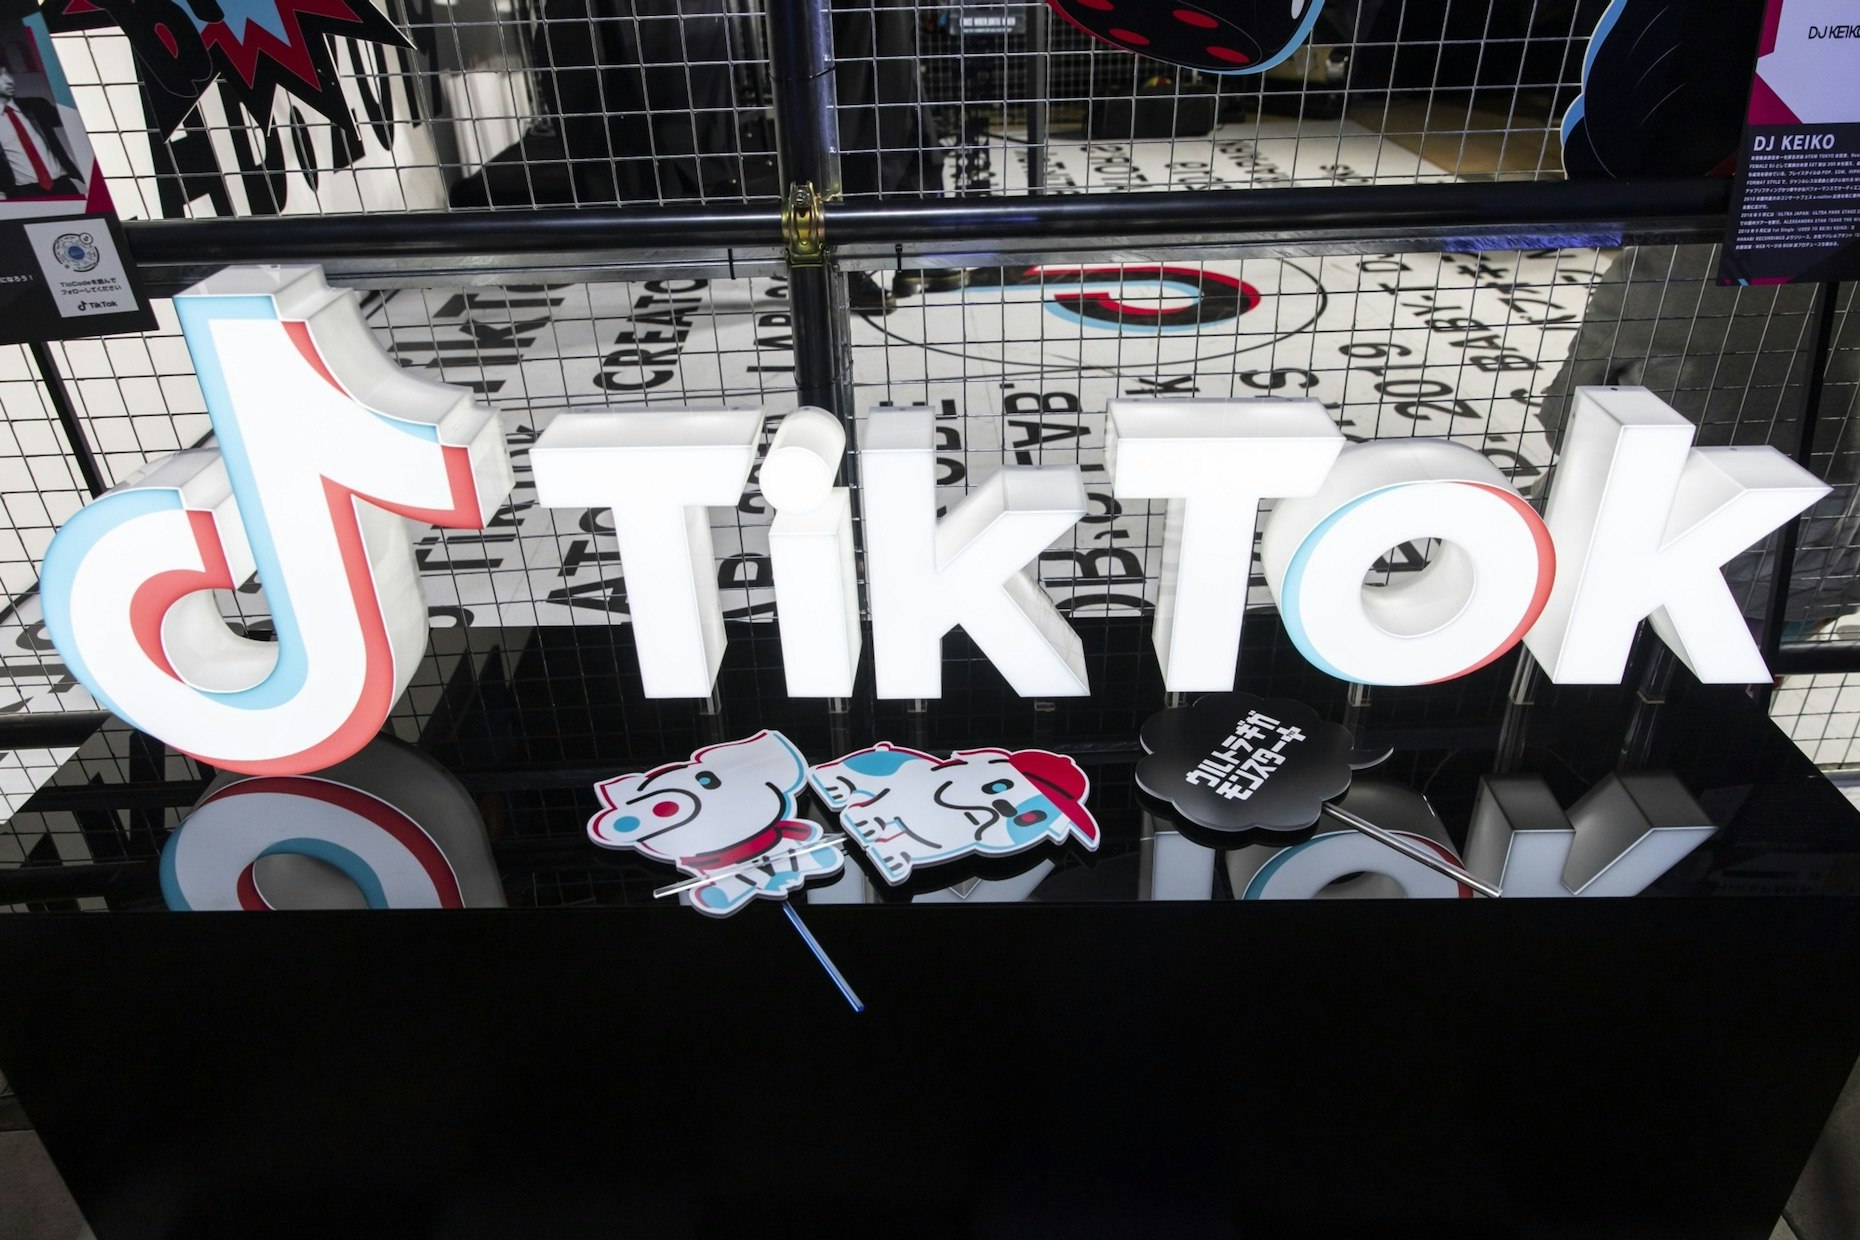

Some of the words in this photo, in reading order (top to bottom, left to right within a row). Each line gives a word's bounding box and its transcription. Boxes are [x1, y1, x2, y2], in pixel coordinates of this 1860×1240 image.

[1808, 26, 1828, 39] DJ
[1753, 135, 1775, 151] DJ
[1781, 134, 1835, 151] KEIKO
[89, 300, 118, 309] TikTok
[529, 386, 1832, 700] TikTok
[1186, 709, 1280, 788] ウルトラギガ
